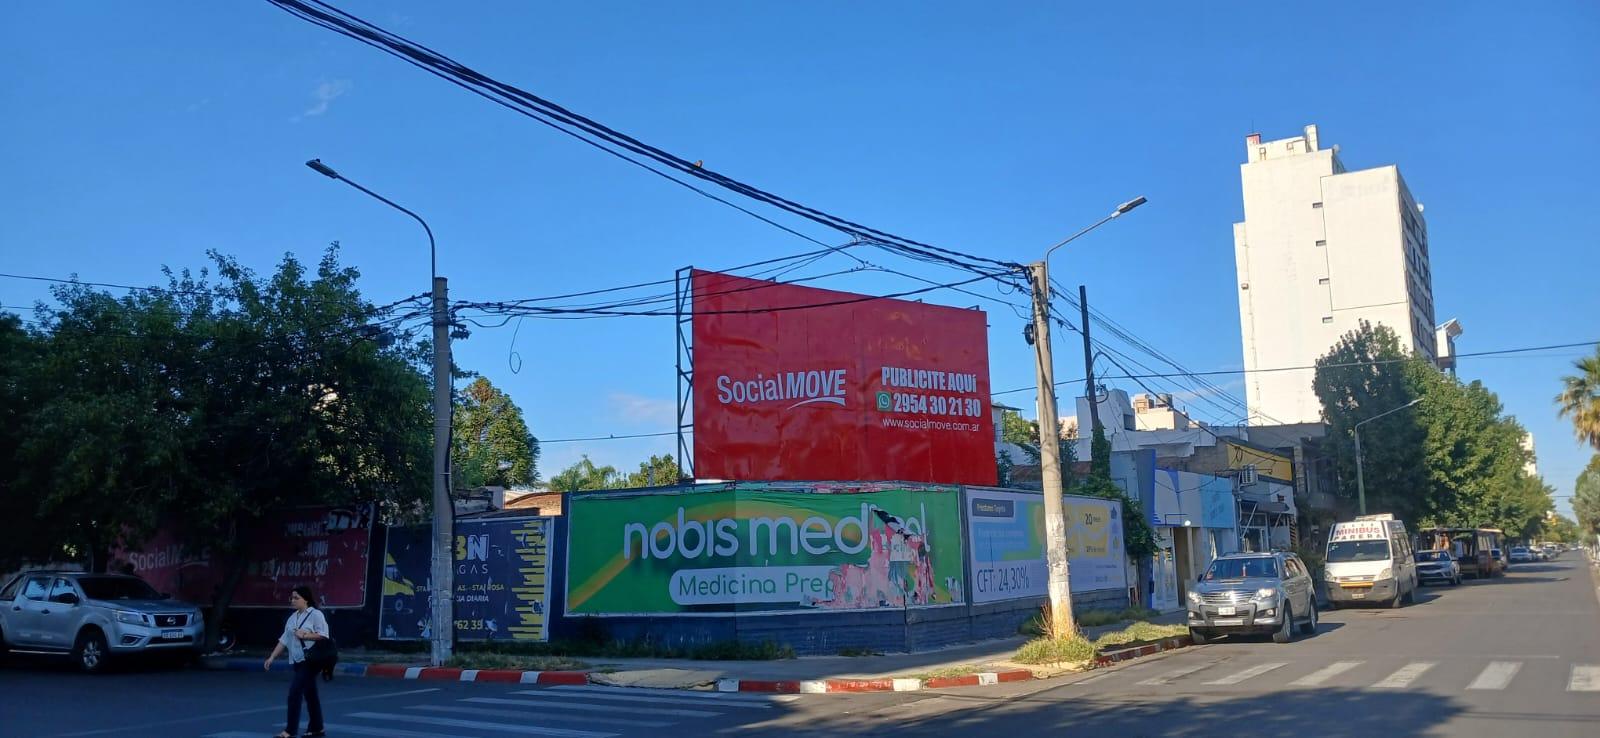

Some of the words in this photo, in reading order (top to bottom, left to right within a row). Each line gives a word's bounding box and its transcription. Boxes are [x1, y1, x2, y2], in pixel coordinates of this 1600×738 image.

[717, 369, 846, 404] SocialMOVE
[881, 367, 945, 390] PUBLICITE
[893, 393, 927, 414] 2954
[929, 396, 946, 415] 30
[948, 397, 962, 416] 21
[964, 398, 981, 417] 30
[882, 418, 980, 432] www.socialmove.com.ar
[624, 507, 739, 560] nobis
[1336, 526, 1381, 536] MINIBUS
[679, 574, 777, 596] Medicina
[976, 569, 996, 593] CFT:
[998, 566, 1030, 592] 24,30%
